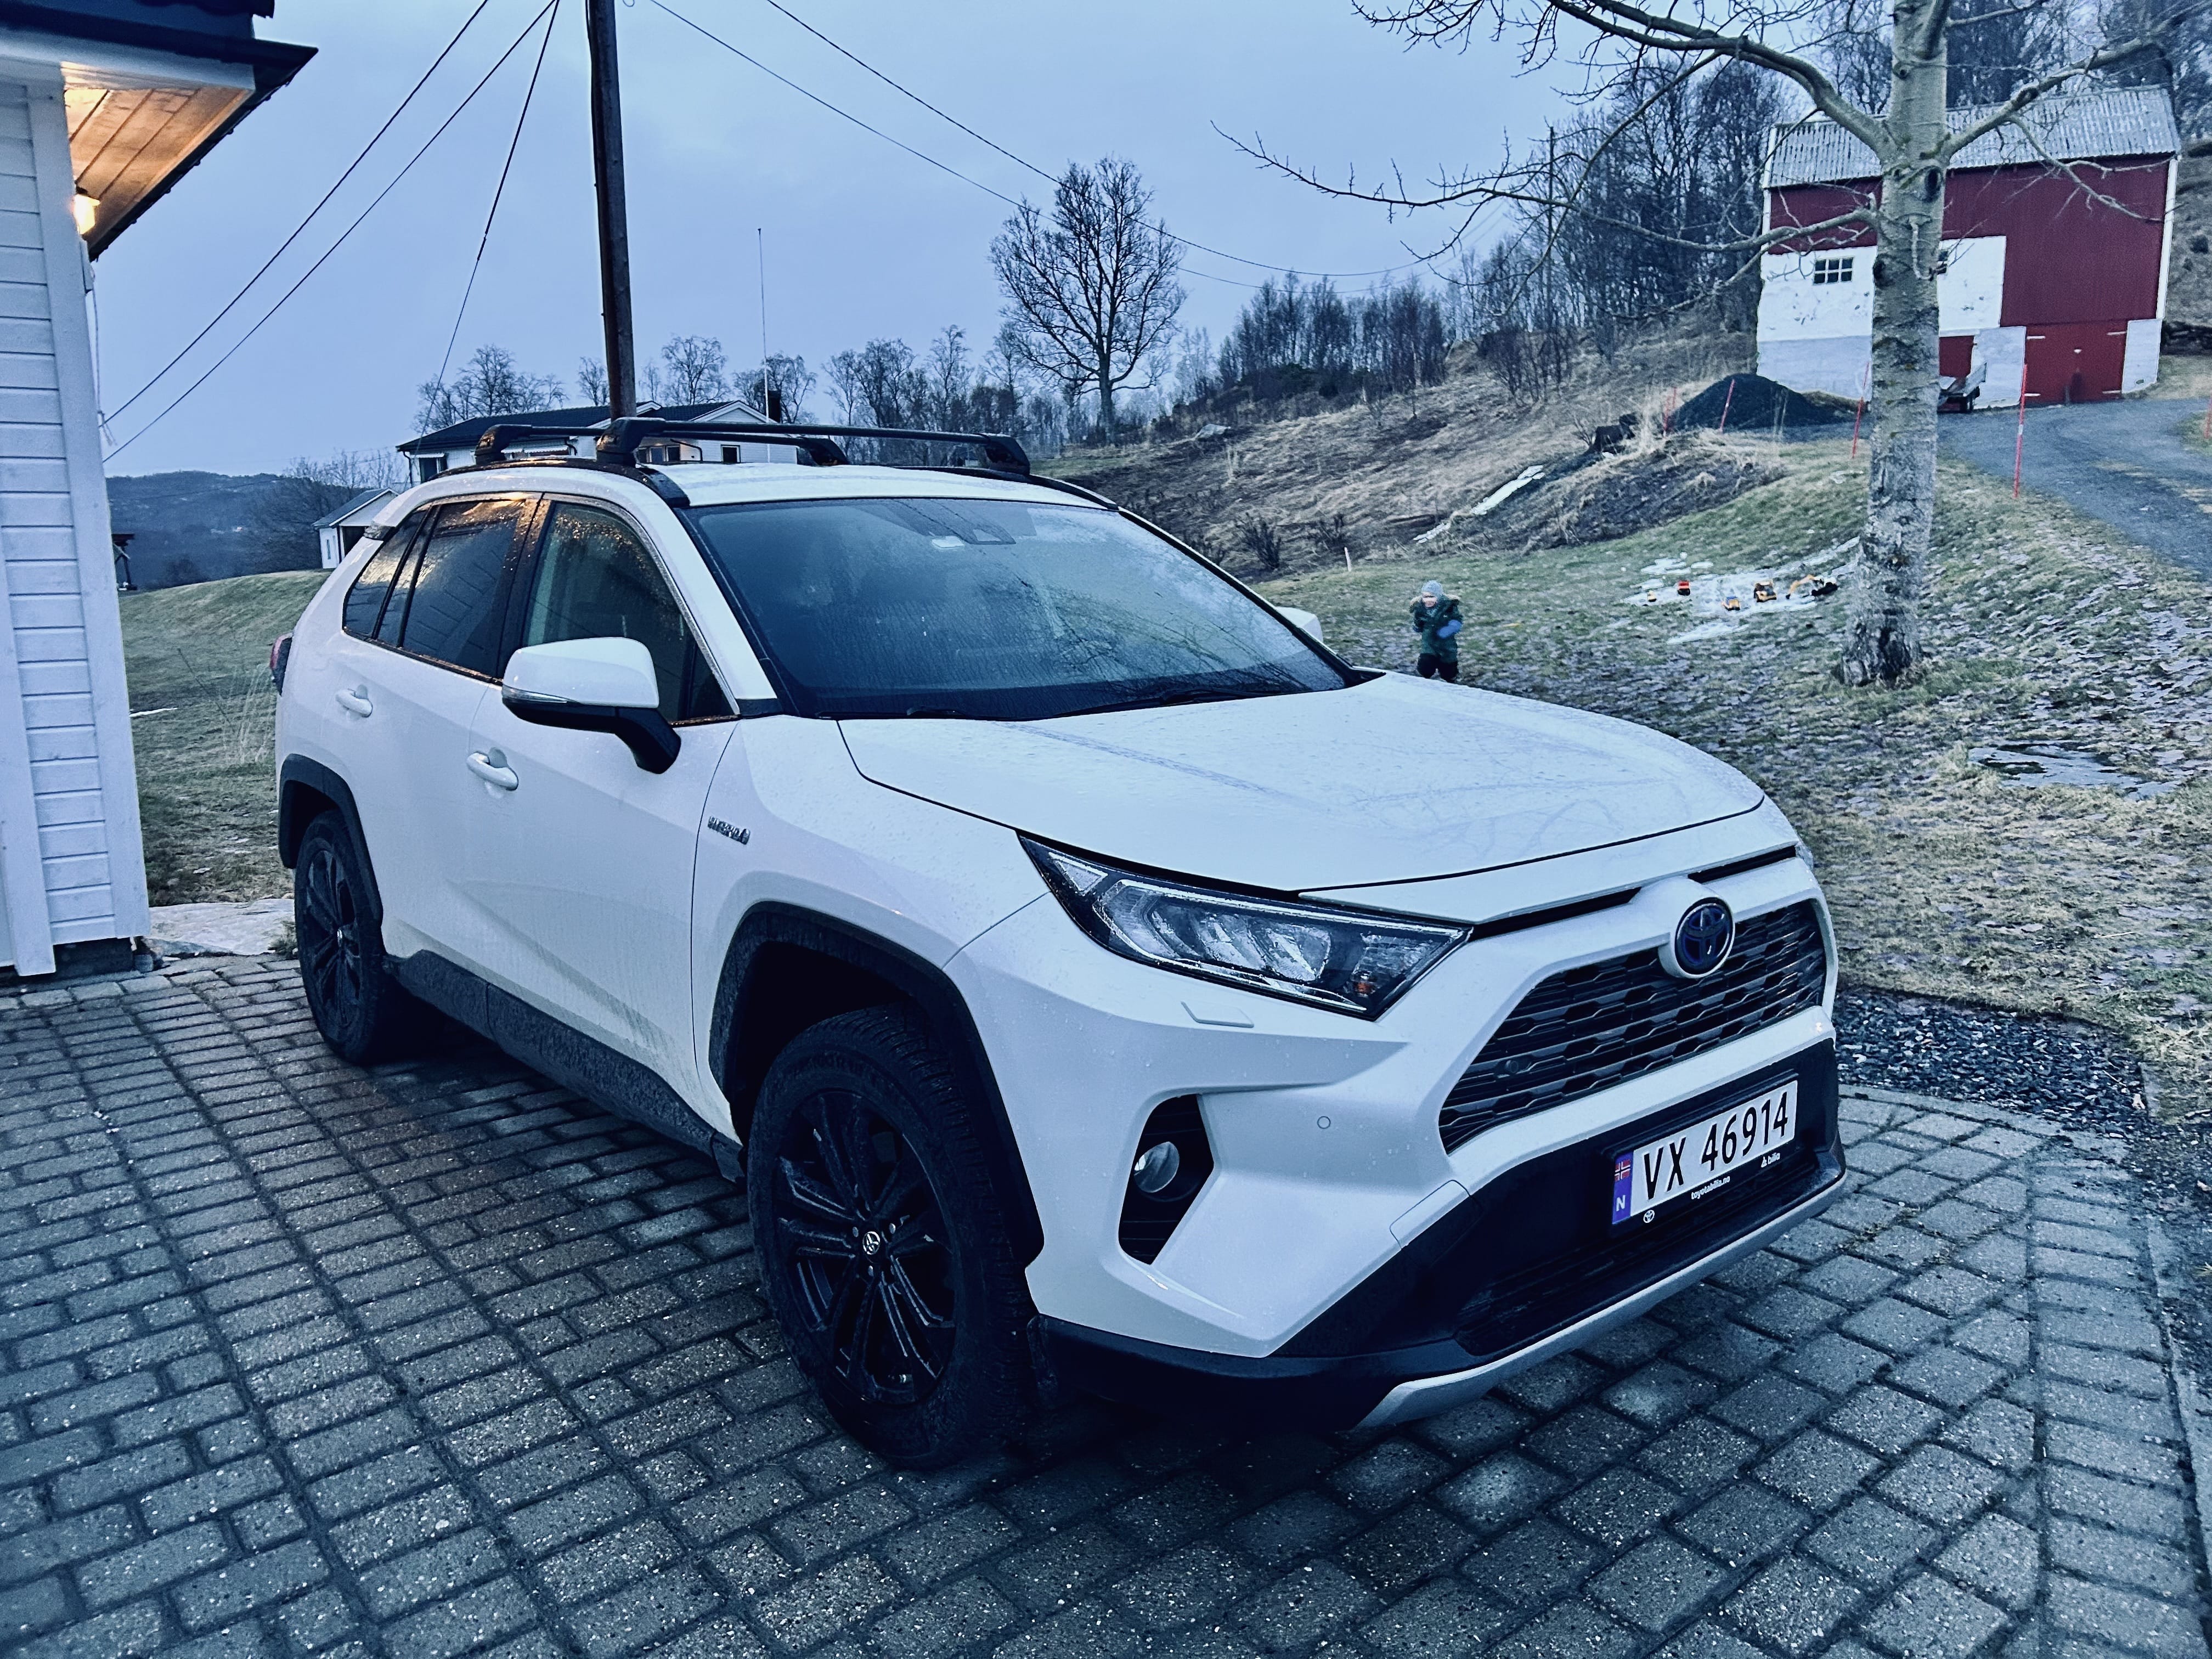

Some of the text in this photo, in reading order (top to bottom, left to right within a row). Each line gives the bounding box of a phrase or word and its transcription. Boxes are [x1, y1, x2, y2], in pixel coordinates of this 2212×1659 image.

[1644, 1092, 1788, 1200] VX 46914
[1616, 1195, 1626, 1211] N
